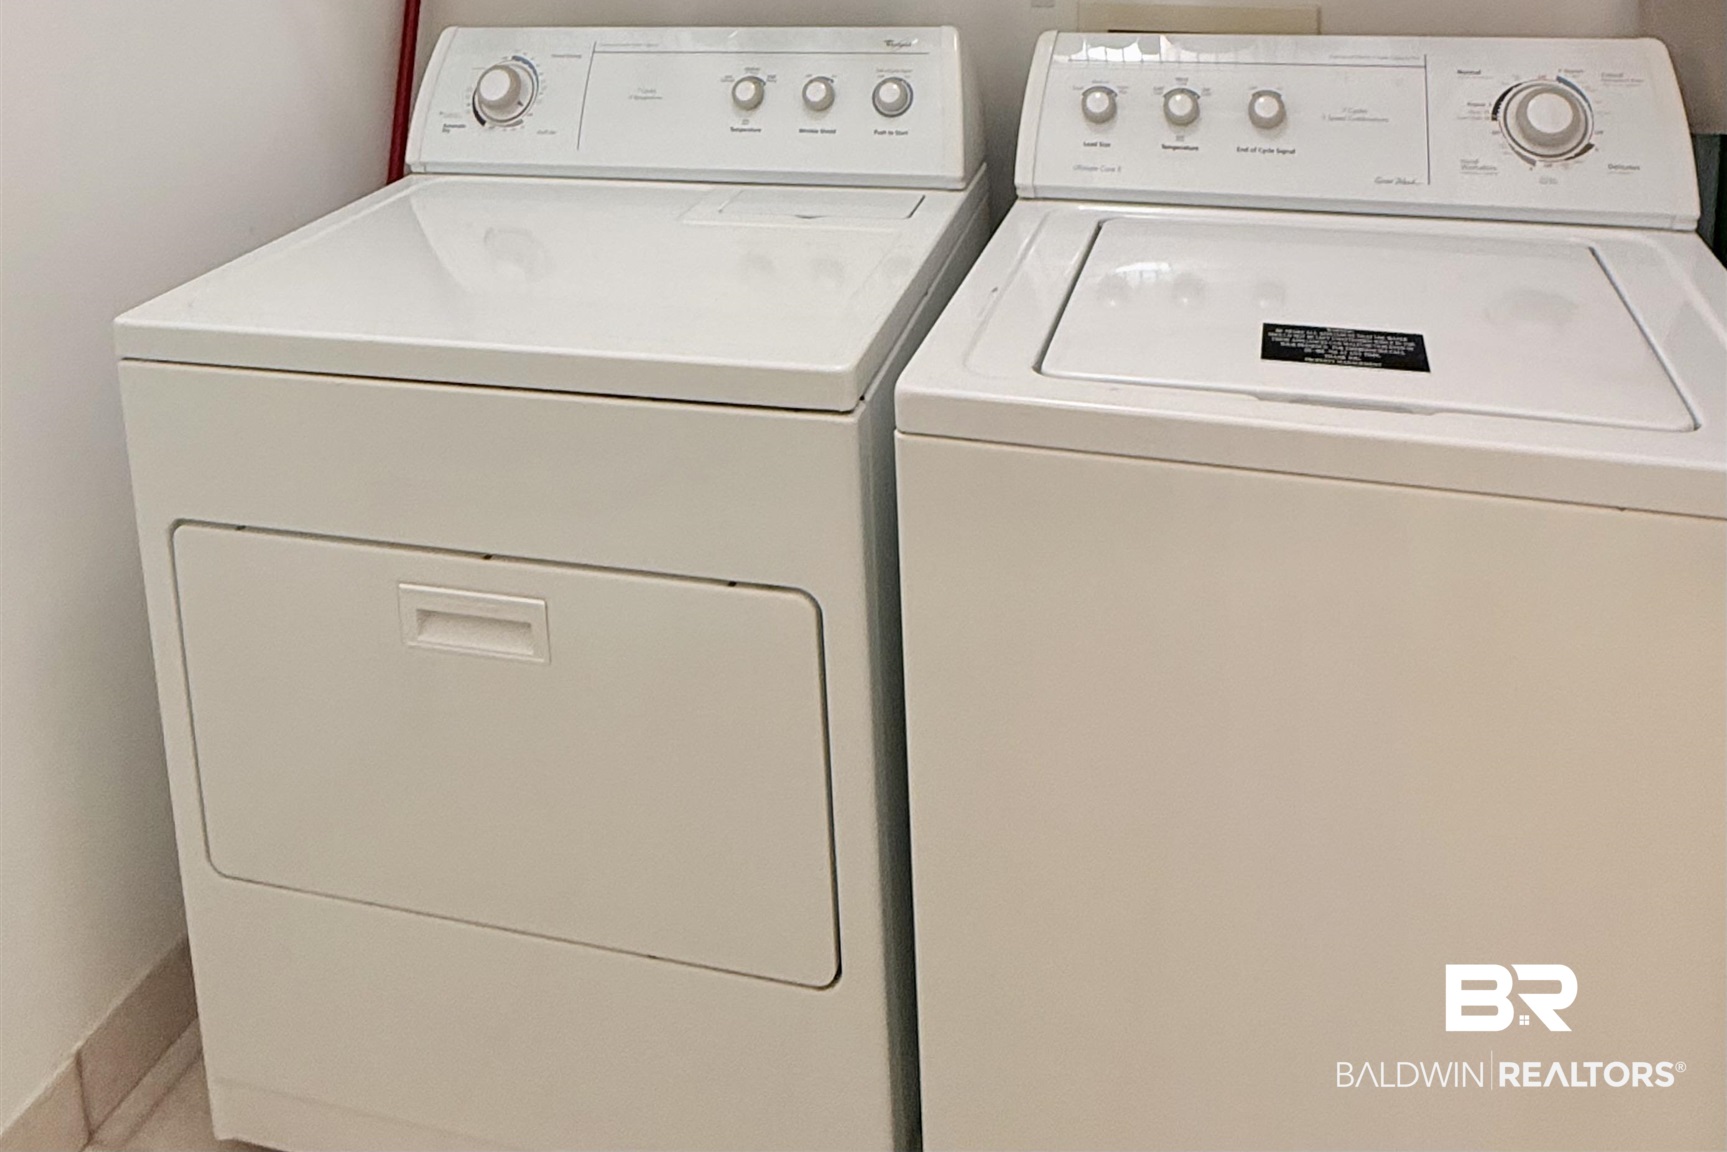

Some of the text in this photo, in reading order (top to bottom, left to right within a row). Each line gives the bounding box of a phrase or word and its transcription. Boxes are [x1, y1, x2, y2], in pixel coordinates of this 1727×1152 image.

[1161, 143, 1199, 151] Temperature
[1258, 148, 1274, 156] Cycle
[1276, 148, 1295, 156] Signal
